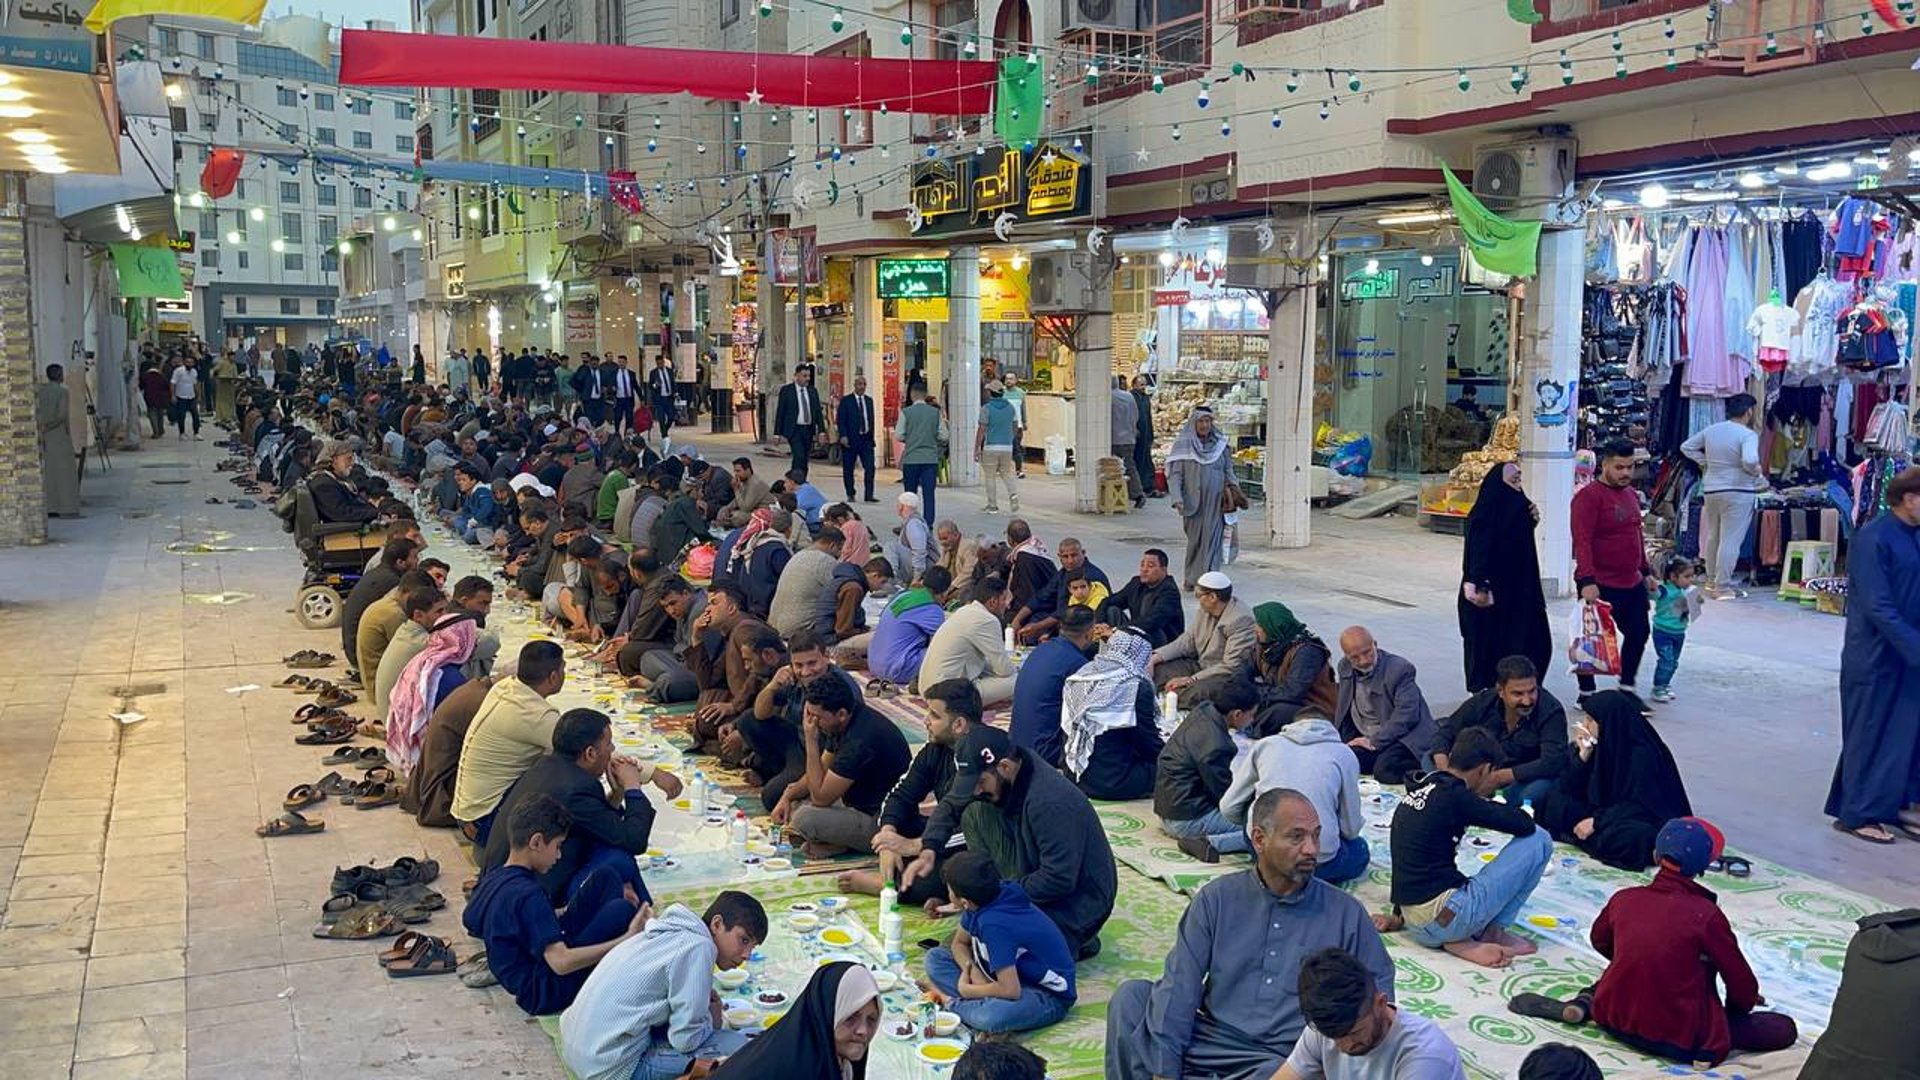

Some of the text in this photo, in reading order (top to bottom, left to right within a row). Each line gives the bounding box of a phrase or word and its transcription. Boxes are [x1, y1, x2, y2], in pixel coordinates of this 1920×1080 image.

[914, 263, 944, 274] محمد
[1407, 264, 1455, 304] النجم
[980, 747, 996, 765] 3
